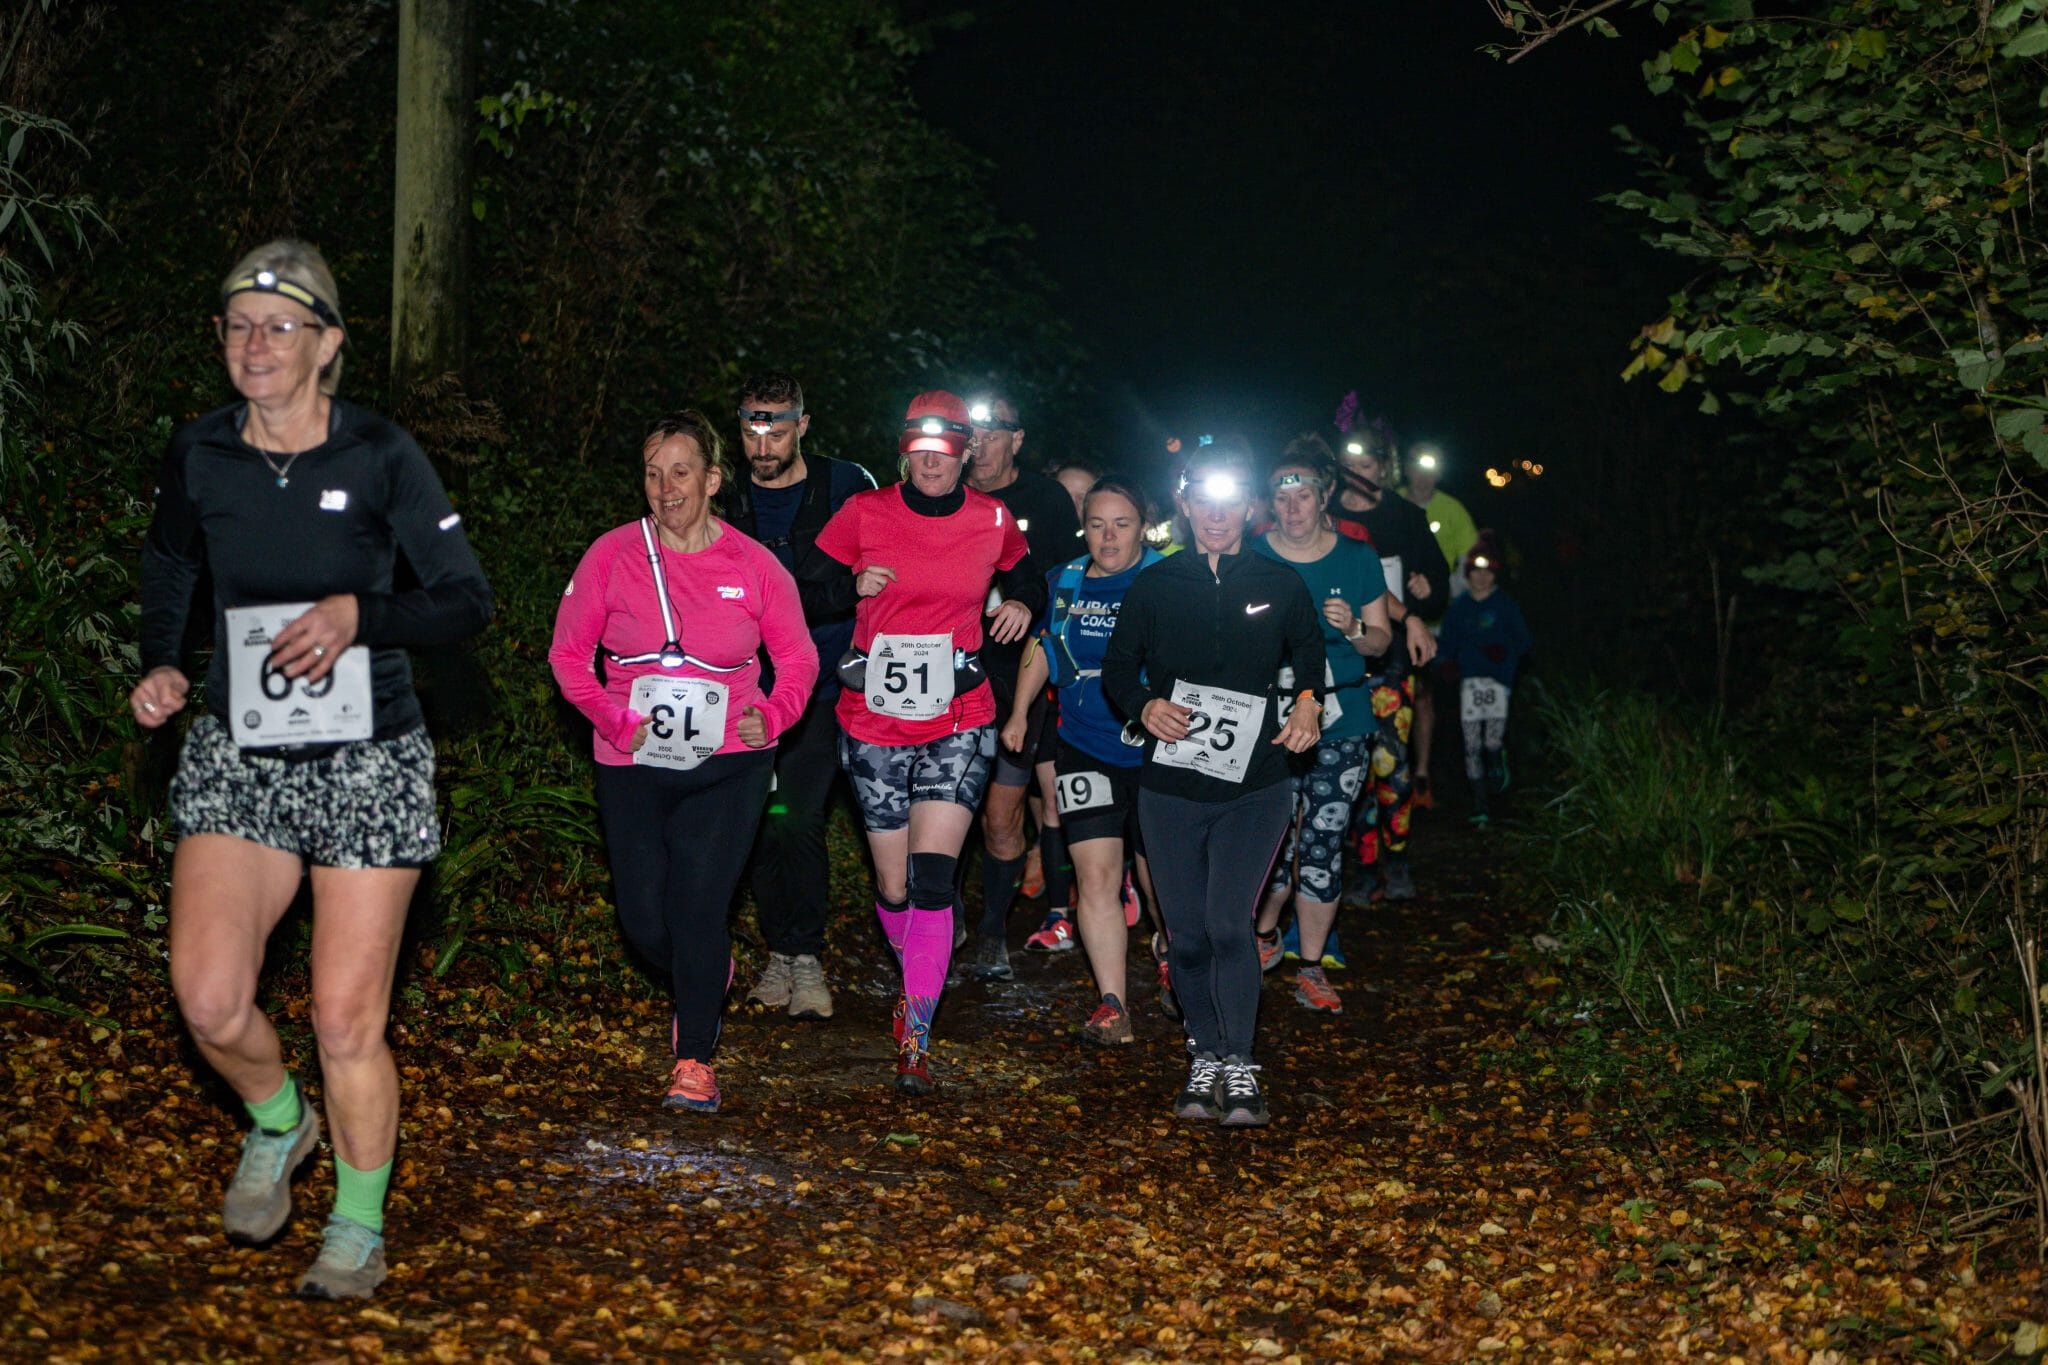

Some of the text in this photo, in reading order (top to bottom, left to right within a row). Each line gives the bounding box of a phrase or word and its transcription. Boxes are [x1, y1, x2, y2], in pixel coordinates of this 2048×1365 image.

[883, 661, 929, 695] 51
[1226, 697, 1252, 709] October
[650, 704, 700, 741] 13
[1184, 710, 1239, 752] 25
[1058, 776, 1092, 809] 19
